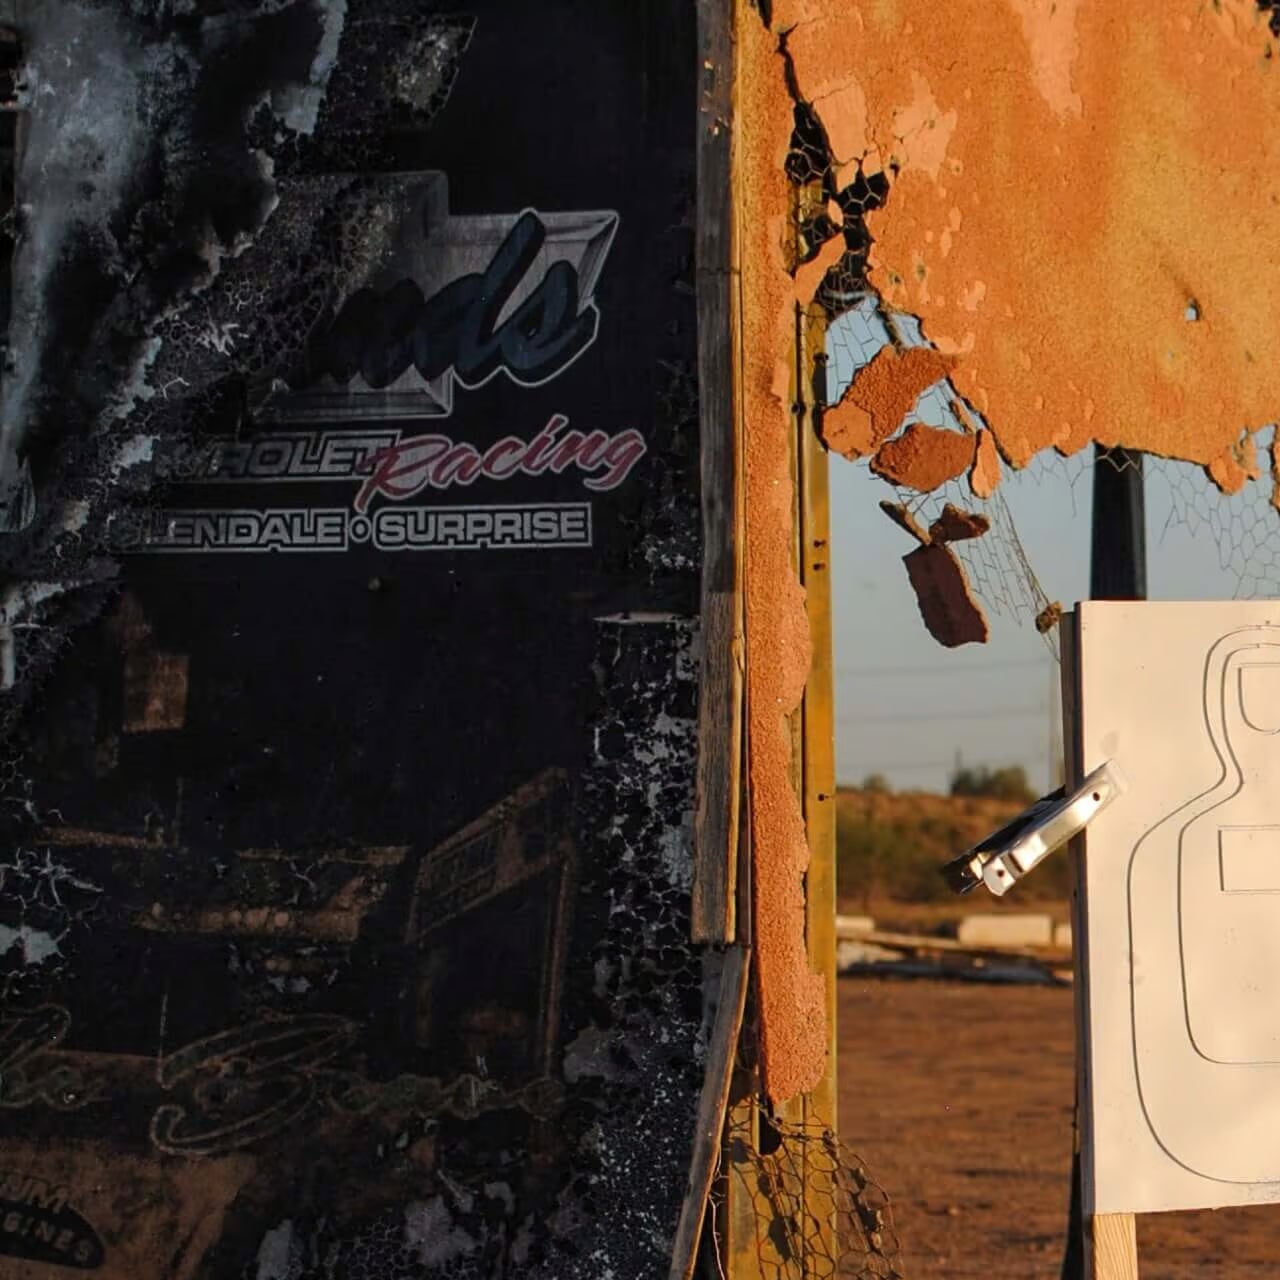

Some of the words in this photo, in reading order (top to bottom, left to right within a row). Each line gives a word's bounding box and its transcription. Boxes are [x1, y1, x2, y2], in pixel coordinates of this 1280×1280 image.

[206, 435, 394, 474] ROLET
[353, 413, 647, 513] Racing
[378, 508, 587, 546] SURPRISE
[0, 1210, 95, 1264] GINES
